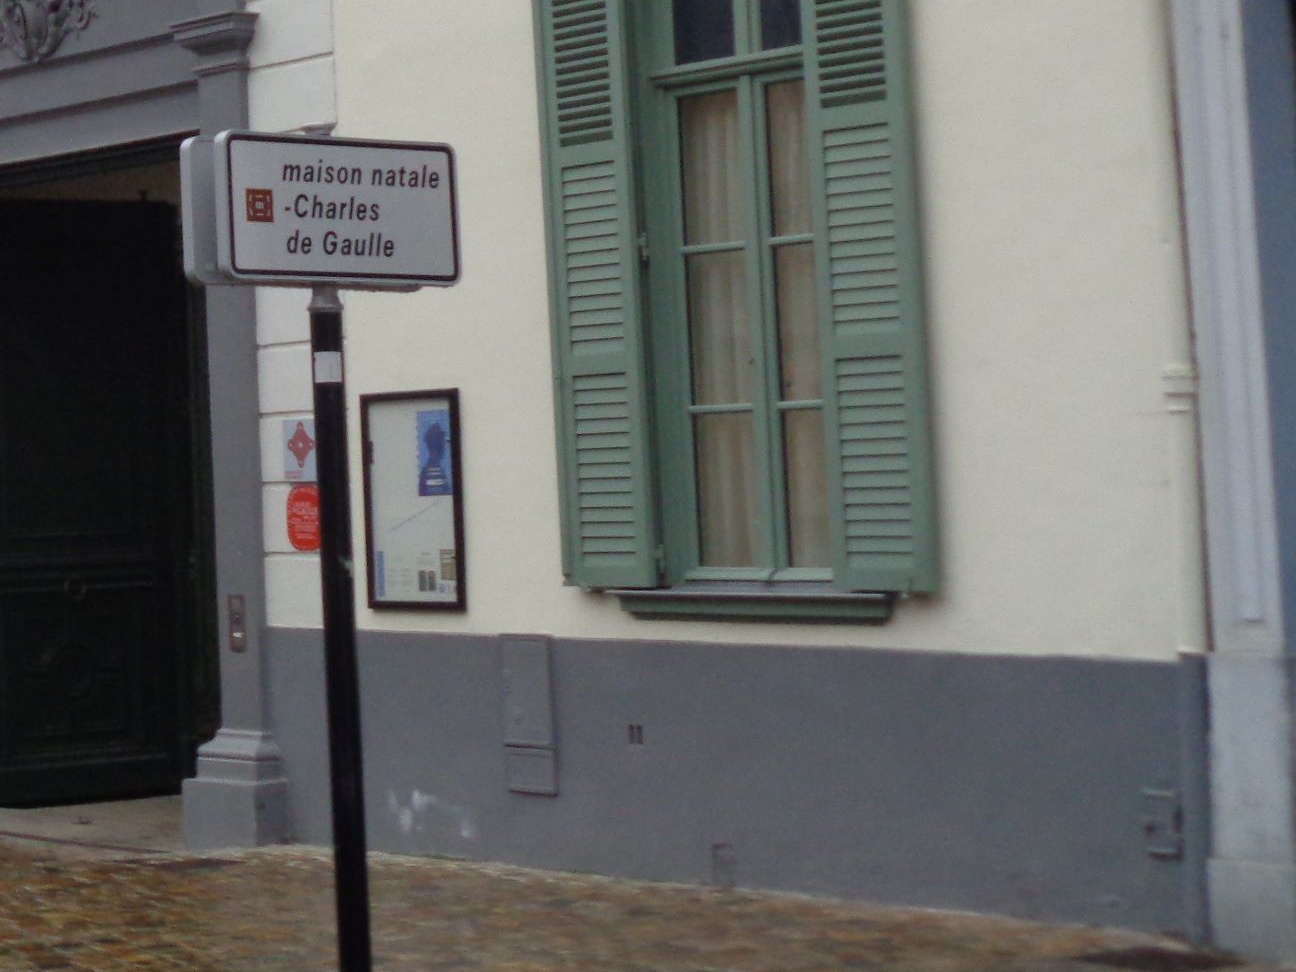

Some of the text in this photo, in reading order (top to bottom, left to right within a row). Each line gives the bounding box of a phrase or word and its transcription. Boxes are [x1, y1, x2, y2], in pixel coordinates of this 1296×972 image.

[283, 159, 440, 189] maison natale
[287, 230, 395, 258] de Gaulle
